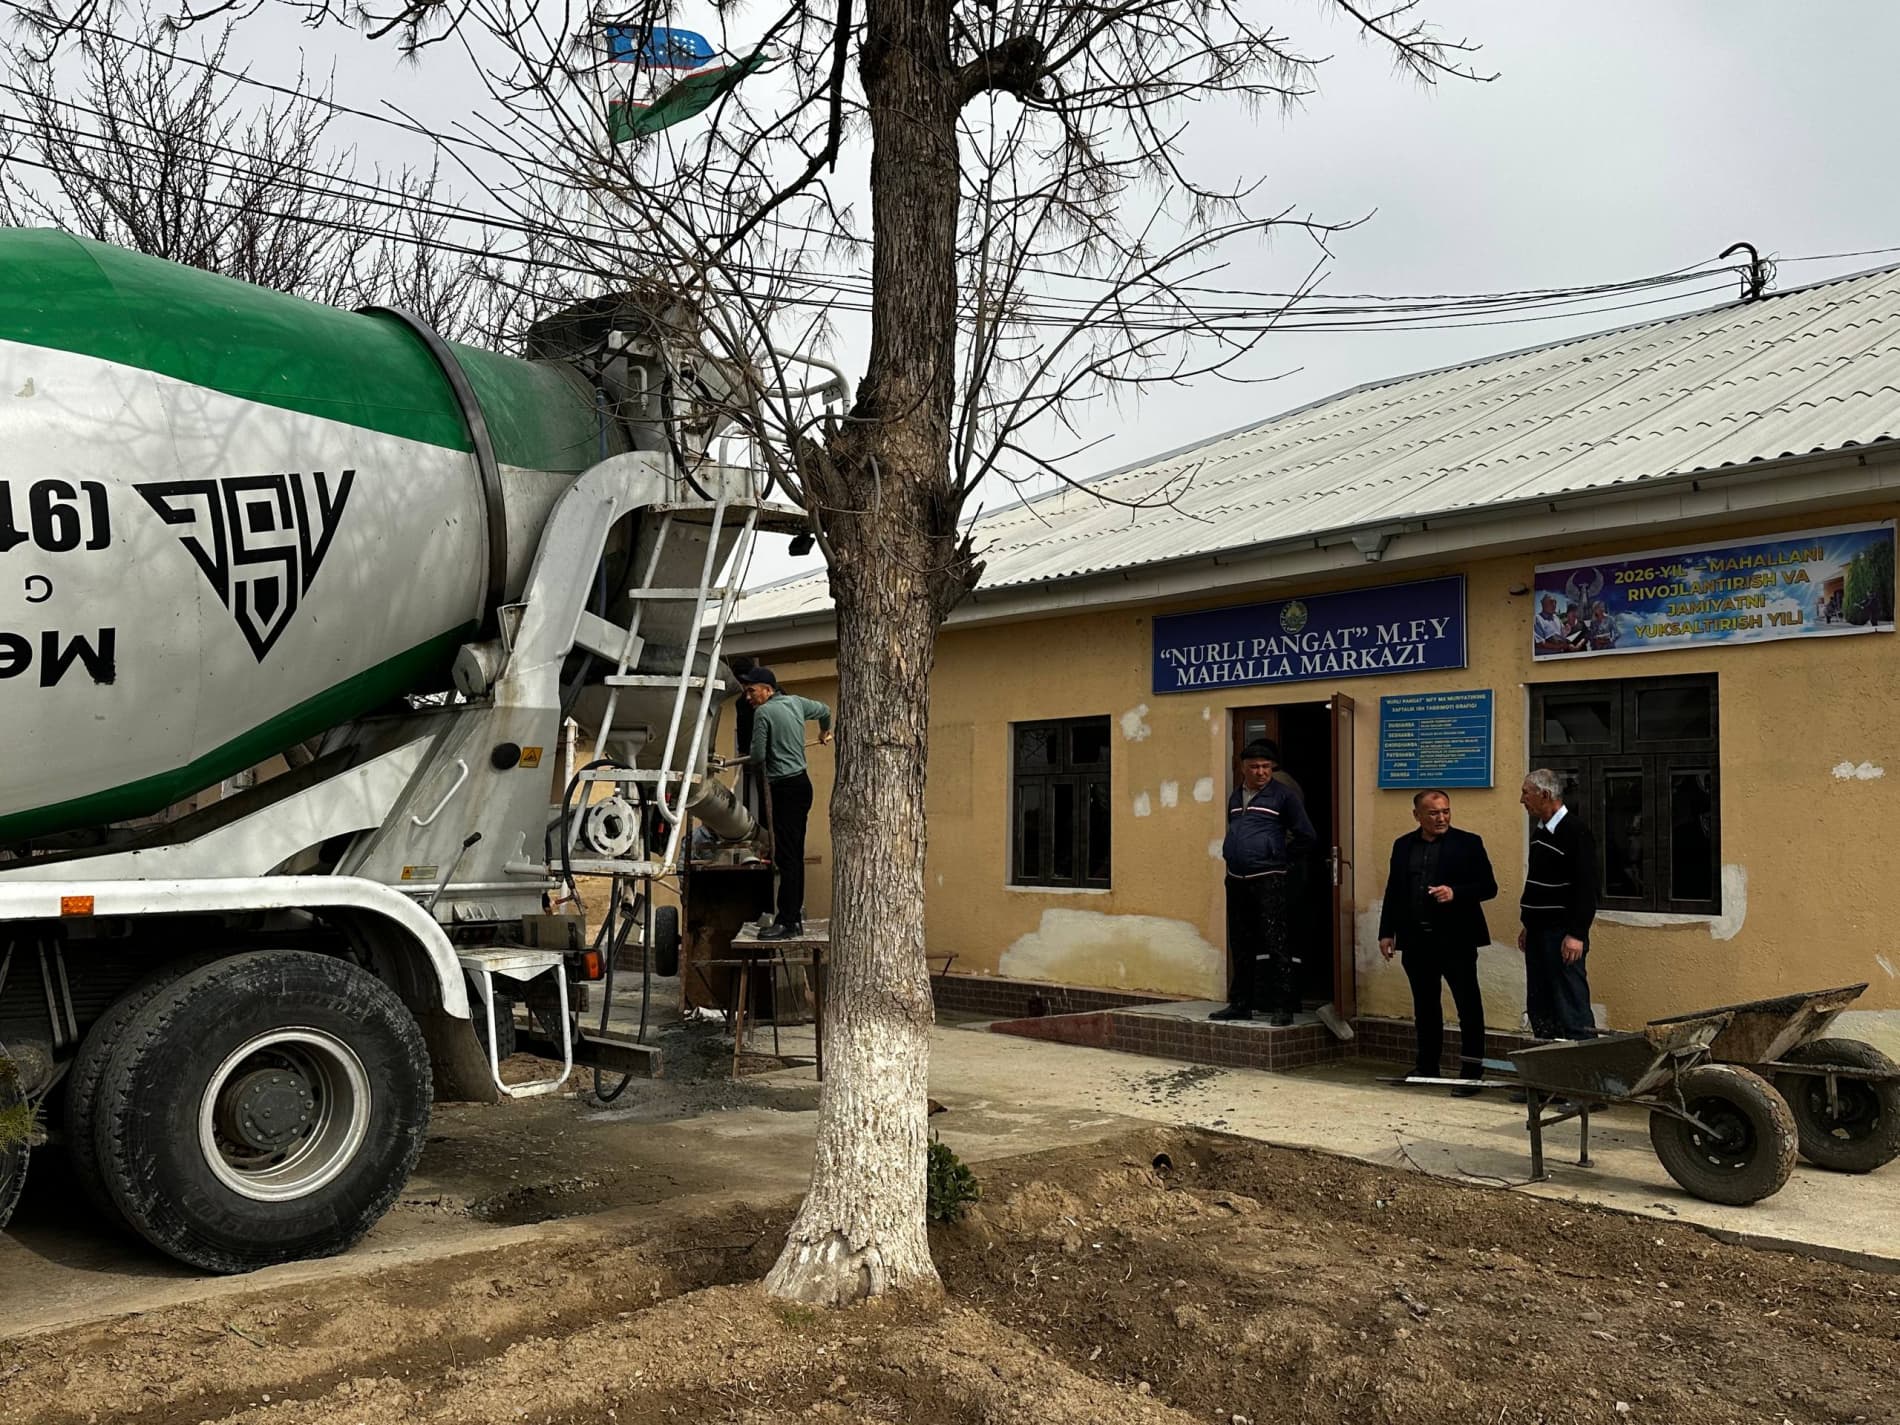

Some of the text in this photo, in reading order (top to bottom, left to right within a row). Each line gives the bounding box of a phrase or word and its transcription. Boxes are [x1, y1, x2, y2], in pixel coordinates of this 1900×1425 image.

[1614, 564, 1689, 585] 2026-YIL
[1708, 545, 1824, 573] MAHALLANI
[1627, 567, 1810, 602] RIVOJLANTIRISH VA
[1634, 609, 1804, 639] YUKSALTIRISH YILI
[1667, 594, 1766, 618] JAMIYATNI
[1161, 617, 1450, 667] “NURLI PANGAT” M.F.Y
[1176, 643, 1426, 686] MAHALLA MARKAZI
